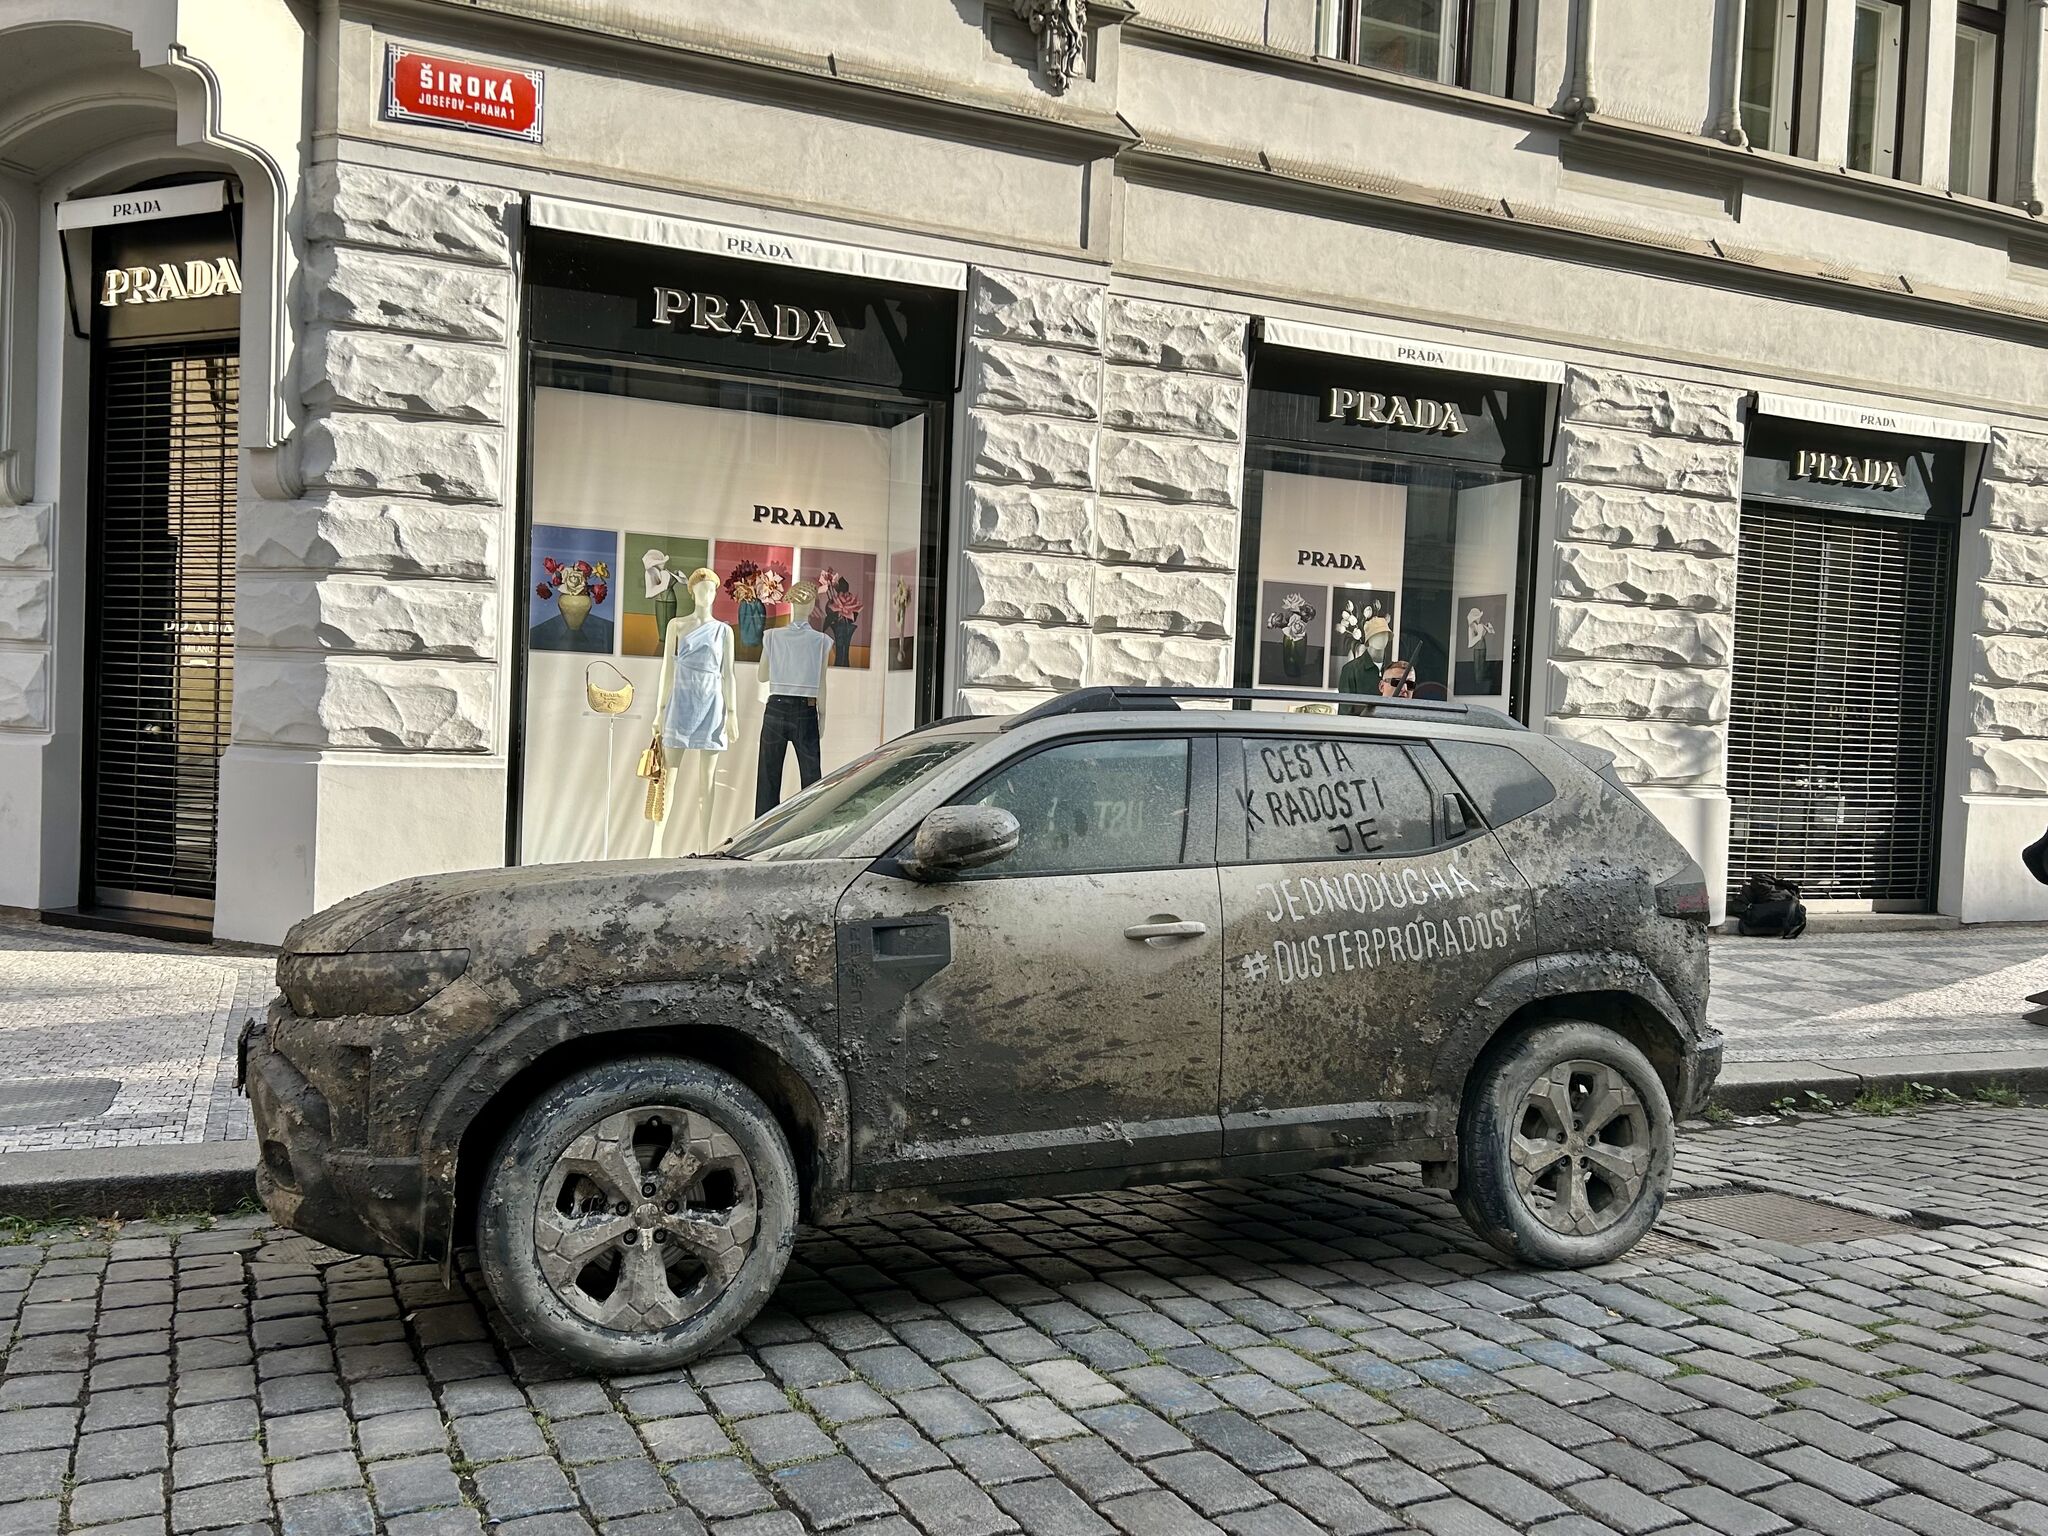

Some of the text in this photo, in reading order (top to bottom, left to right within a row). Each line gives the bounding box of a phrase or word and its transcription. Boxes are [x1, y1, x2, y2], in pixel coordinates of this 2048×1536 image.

[420, 62, 514, 105] ŠIROKÁ
[510, 109, 515, 121] 1
[112, 199, 162, 217] PRADA
[727, 237, 794, 260] PRADA
[100, 256, 242, 307] PRADA
[652, 287, 847, 348] PRADA
[1397, 347, 1444, 364] PRADA
[1329, 387, 1469, 433] PRADA
[1860, 413, 1897, 429] PRADA
[1797, 450, 1906, 489] PRADA
[752, 504, 844, 530] PRADA
[1297, 549, 1367, 571] PRADA
[1261, 741, 1356, 784] CESTA
[1235, 776, 1385, 833] K RADOSTI
[1327, 818, 1384, 854] JE
[1256, 849, 1481, 923] JEDNODUCHÁ
